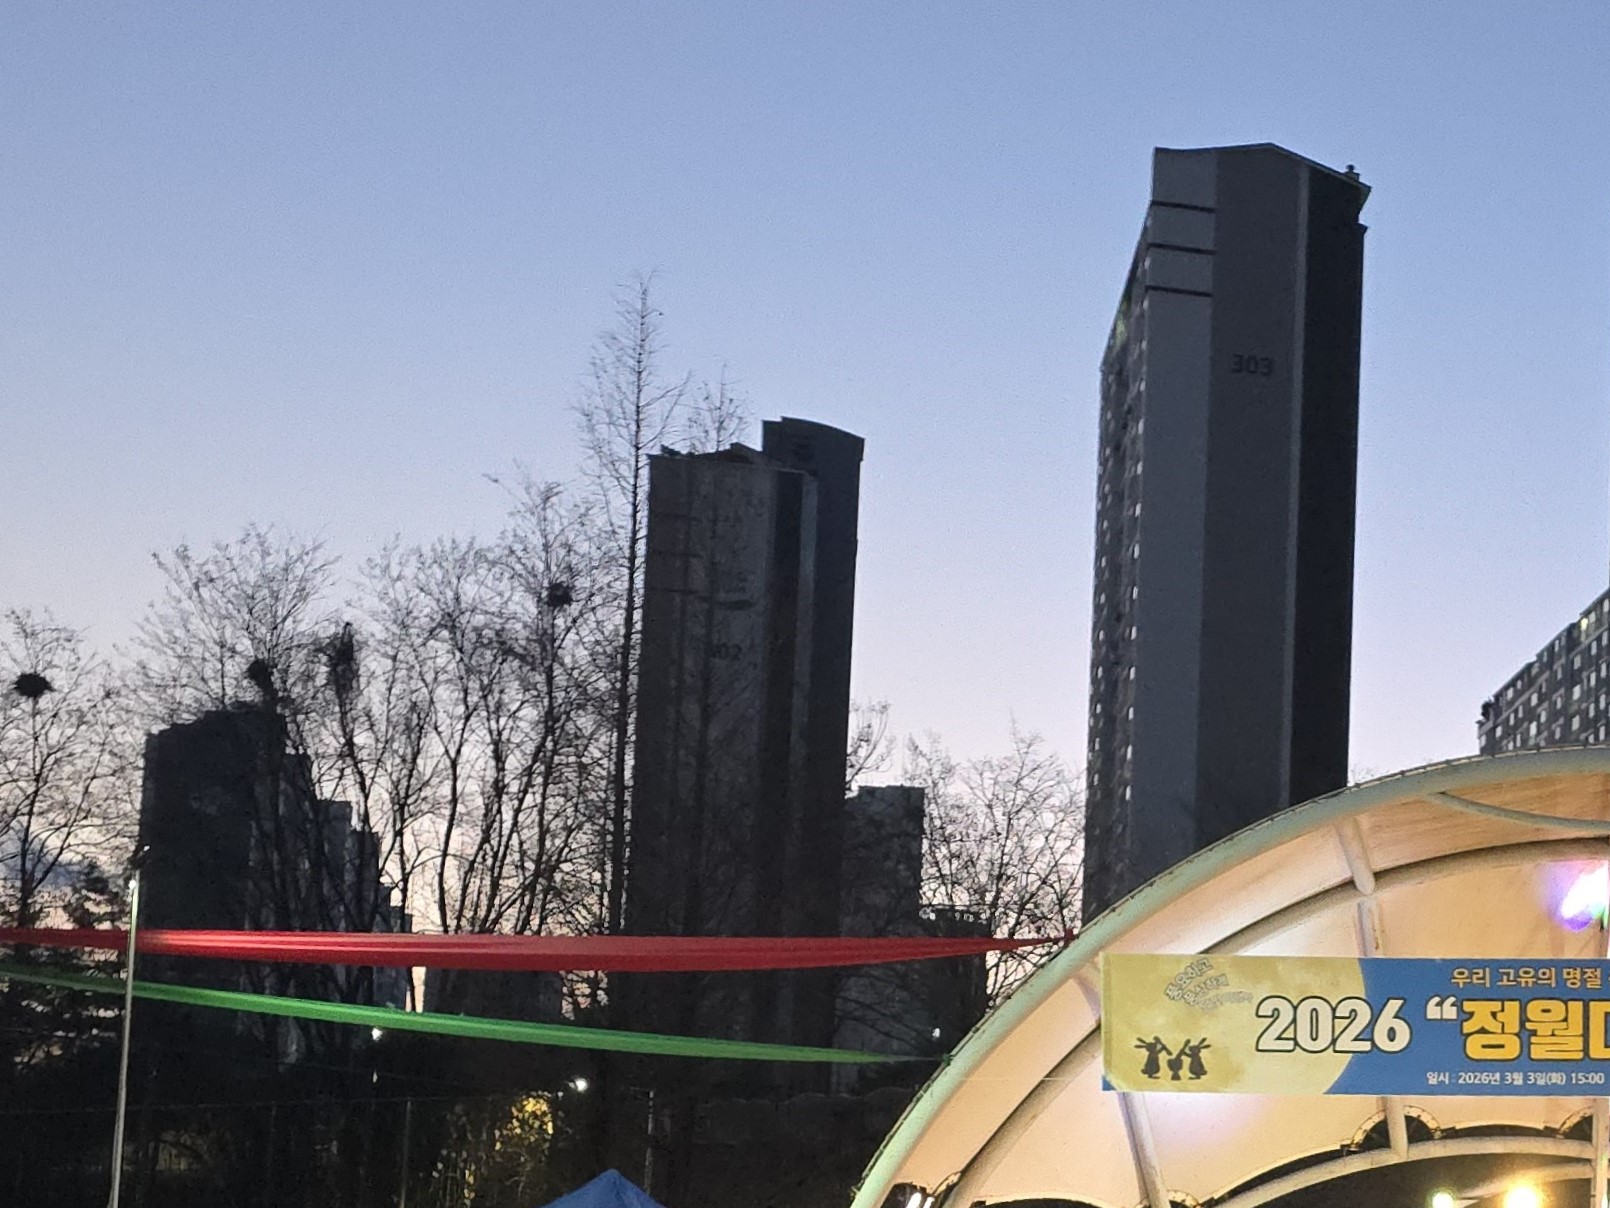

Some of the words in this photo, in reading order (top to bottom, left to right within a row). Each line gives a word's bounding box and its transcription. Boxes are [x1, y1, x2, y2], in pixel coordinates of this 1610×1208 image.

[1231, 353, 1275, 377] 303
[1451, 967, 1490, 988] 우리
[1496, 967, 1557, 988] 고유의
[1562, 967, 1602, 989] 명절
[1255, 995, 1412, 1053] 2026
[1426, 1071, 1449, 1085] 일시
[1458, 1071, 1500, 1085] 2026년
[1504, 1071, 1524, 1085] 3월
[1527, 1071, 1566, 1086] 3일(화)
[1571, 1072, 1605, 1085] 15:00
